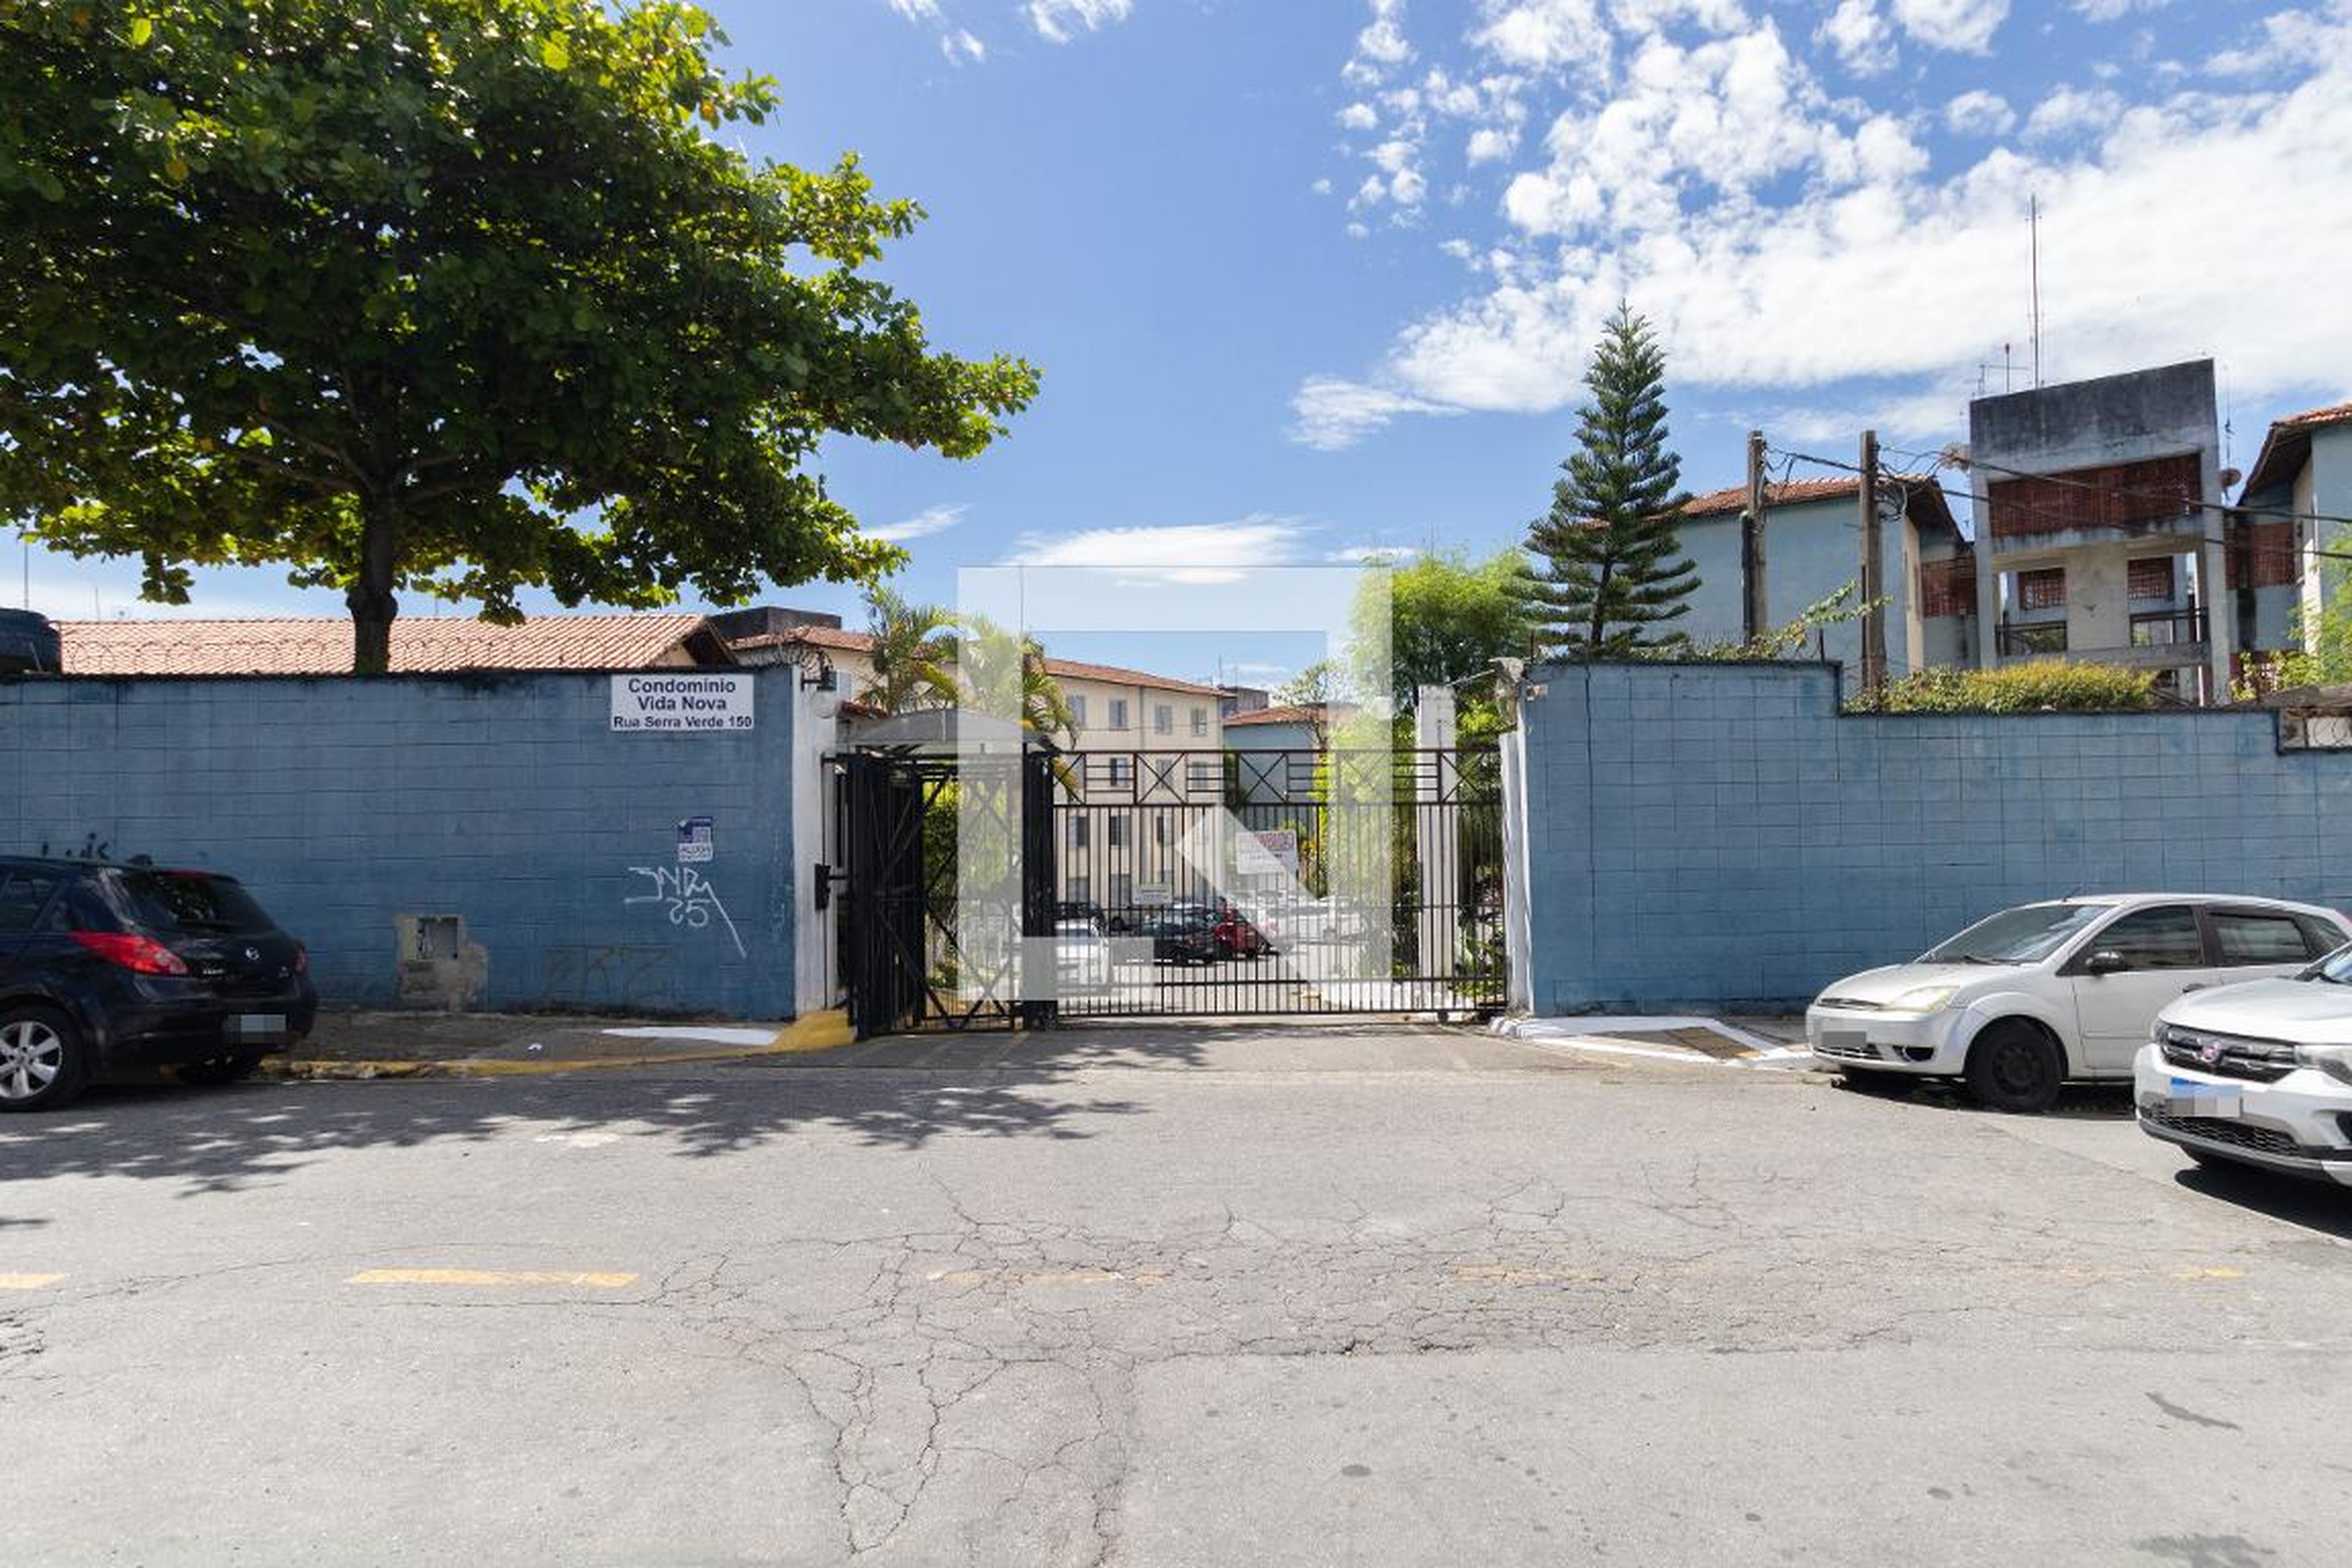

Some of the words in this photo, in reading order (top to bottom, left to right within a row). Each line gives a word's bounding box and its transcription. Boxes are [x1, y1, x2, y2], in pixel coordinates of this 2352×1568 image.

[638, 696, 676, 710] Vida
[682, 696, 726, 710] Nova
[614, 716, 639, 728] Rua
[644, 716, 681, 728] Serra
[685, 716, 723, 728] Verde
[728, 715, 752, 728] 150
